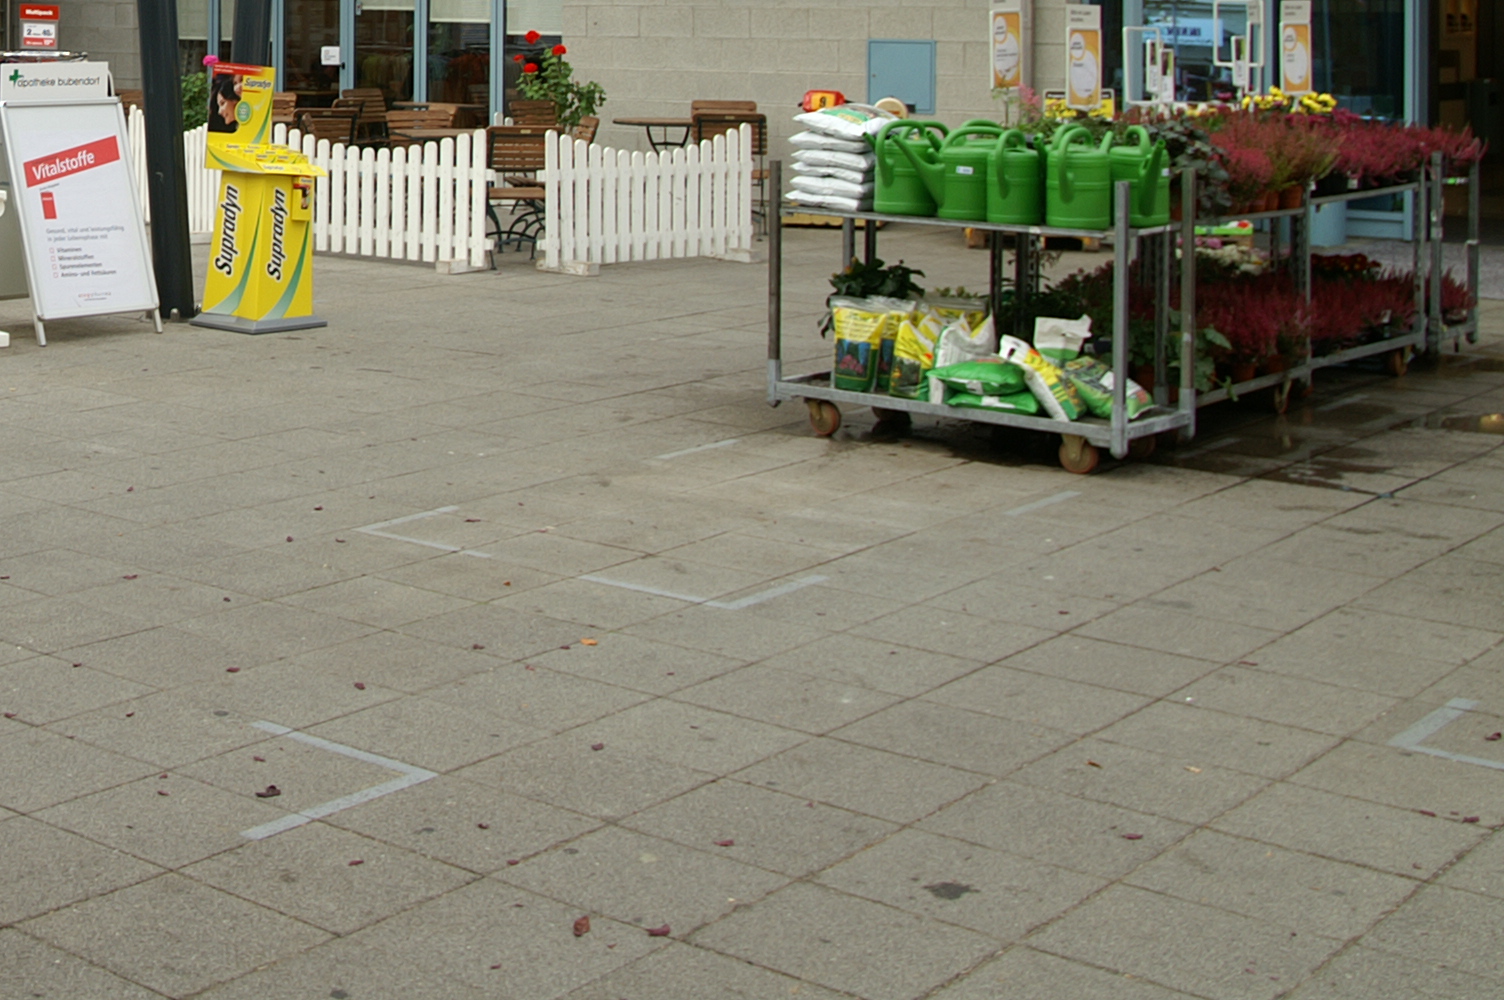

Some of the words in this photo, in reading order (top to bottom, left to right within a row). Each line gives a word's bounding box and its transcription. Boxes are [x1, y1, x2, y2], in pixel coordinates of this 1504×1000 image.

[26, 28, 32, 36] 2
[17, 78, 56, 88] apotheke
[57, 77, 100, 87] bubendorf
[244, 77, 272, 89] Supradyn
[32, 149, 95, 180] Vitalstoffe
[215, 184, 242, 276] Supradyn
[267, 189, 288, 281] Supradyn
